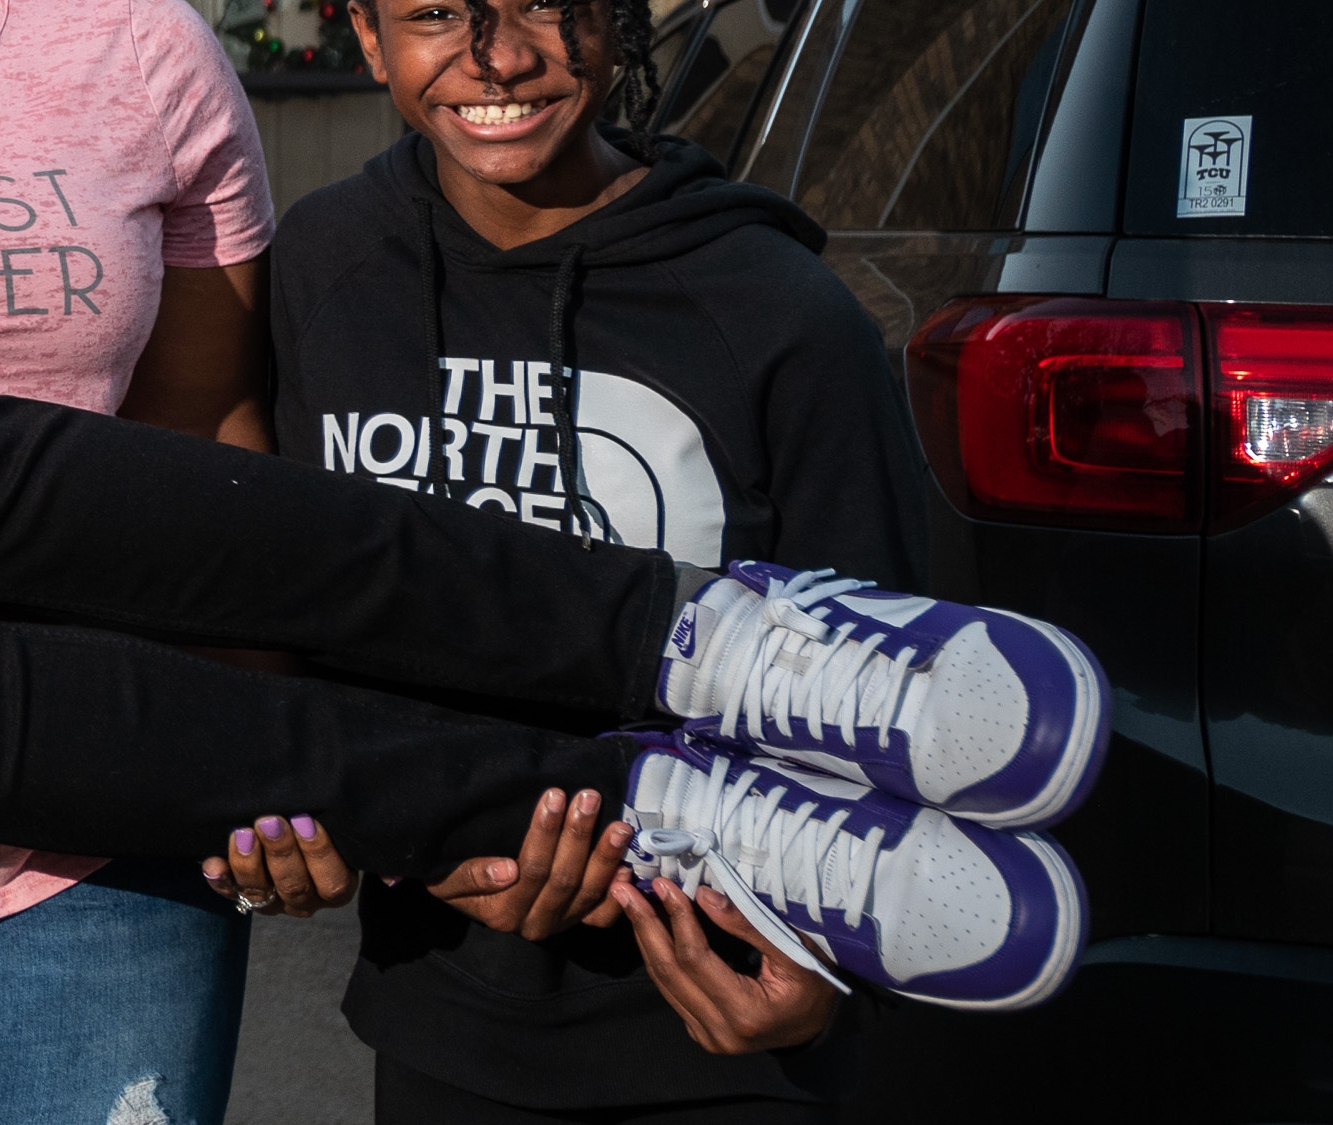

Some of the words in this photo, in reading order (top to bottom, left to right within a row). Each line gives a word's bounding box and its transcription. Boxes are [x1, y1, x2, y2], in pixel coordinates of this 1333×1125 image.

[1196, 168, 1231, 181] TCU
[1189, 198, 1209, 209] TR2
[1211, 198, 1234, 208] 0291
[439, 357, 572, 426] THE
[322, 411, 567, 493] NORTH
[671, 616, 693, 649] NIKE
